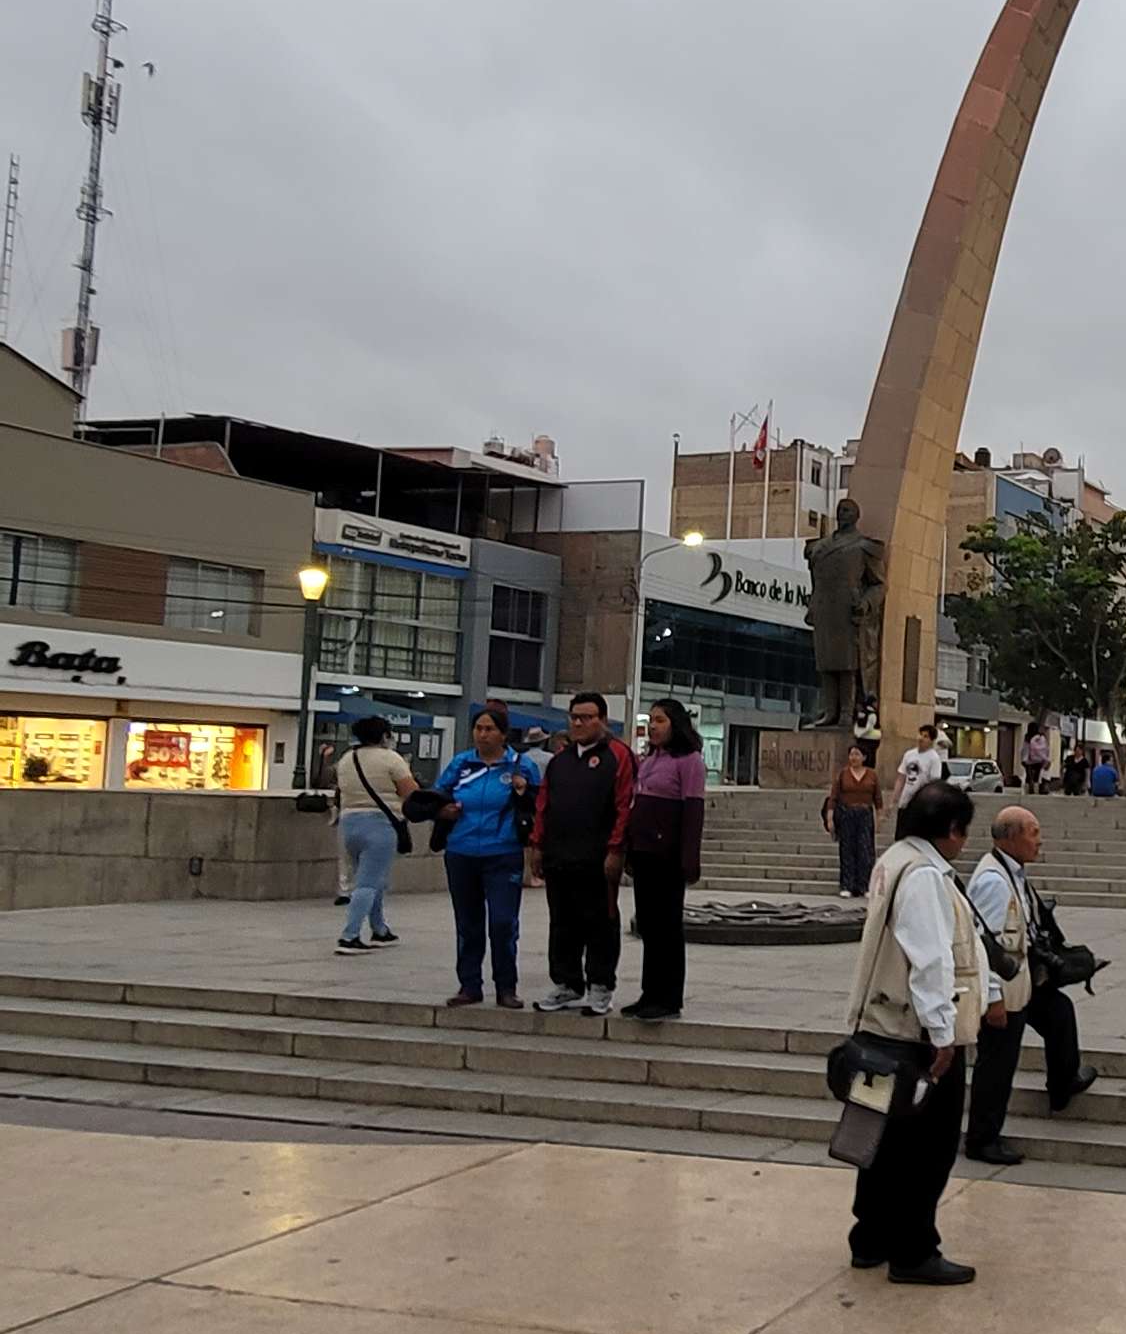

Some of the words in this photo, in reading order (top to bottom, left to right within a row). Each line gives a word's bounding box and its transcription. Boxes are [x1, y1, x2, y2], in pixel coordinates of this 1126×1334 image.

[735, 570, 766, 598] Banco
[769, 578, 782, 601] de
[785, 581, 794, 603] la
[8, 641, 122, 674] Bata
[146, 747, 186, 762] 50%
[761, 749, 831, 772] BOLOGNESI
